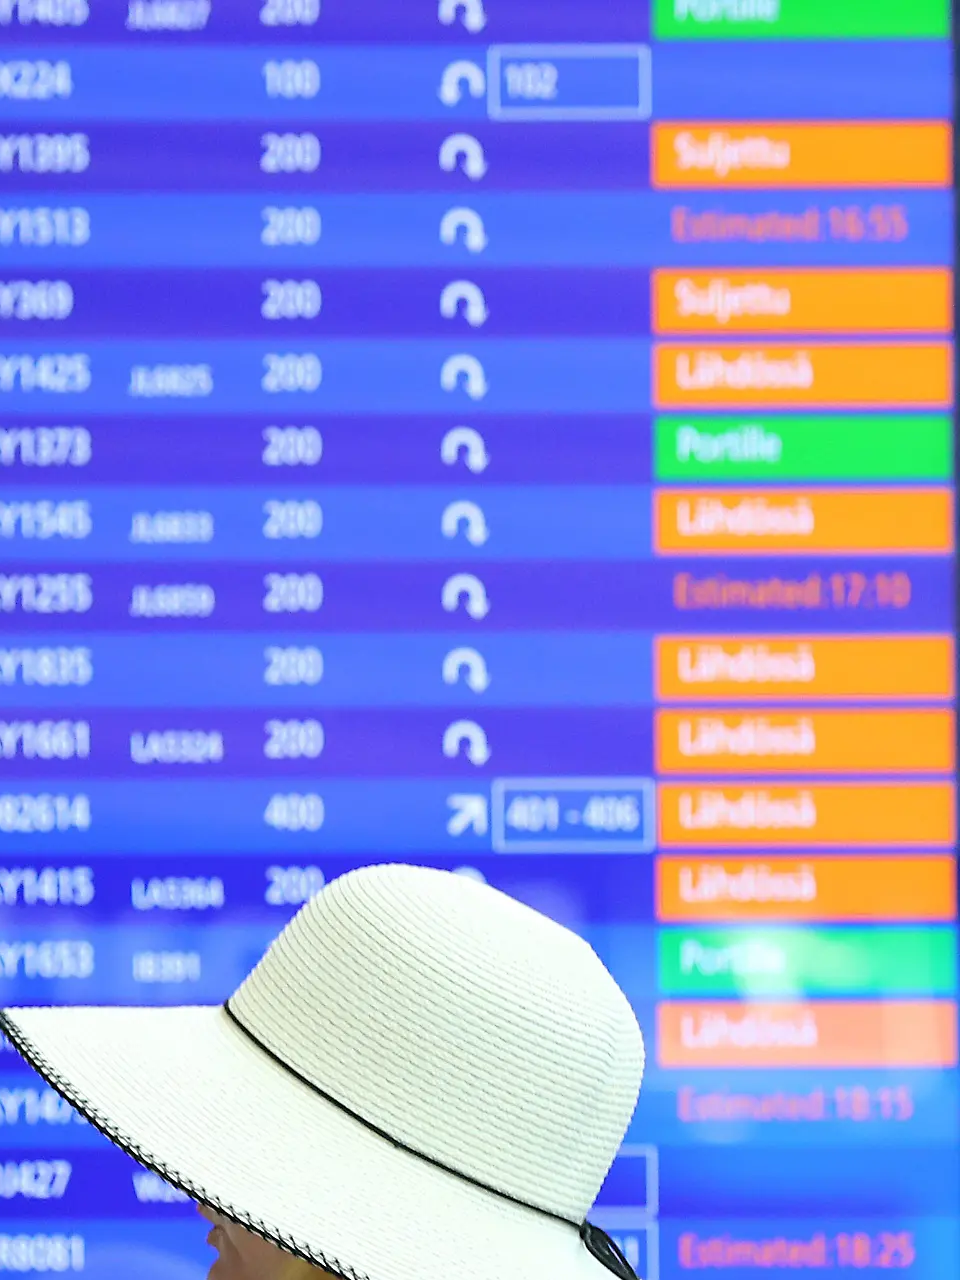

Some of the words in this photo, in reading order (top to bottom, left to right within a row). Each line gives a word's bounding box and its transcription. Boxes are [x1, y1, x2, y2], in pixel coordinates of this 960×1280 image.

[264, 60, 320, 97] 100
[261, 133, 320, 172] 200
[261, 207, 321, 245] 200
[262, 280, 321, 319] 200
[263, 354, 321, 392] 200
[263, 427, 322, 465] 200
[264, 500, 322, 538] 200
[264, 574, 323, 612] 200
[265, 647, 323, 685] 200
[264, 720, 323, 758] 200
[264, 793, 324, 830] 400
[506, 796, 558, 831] 401
